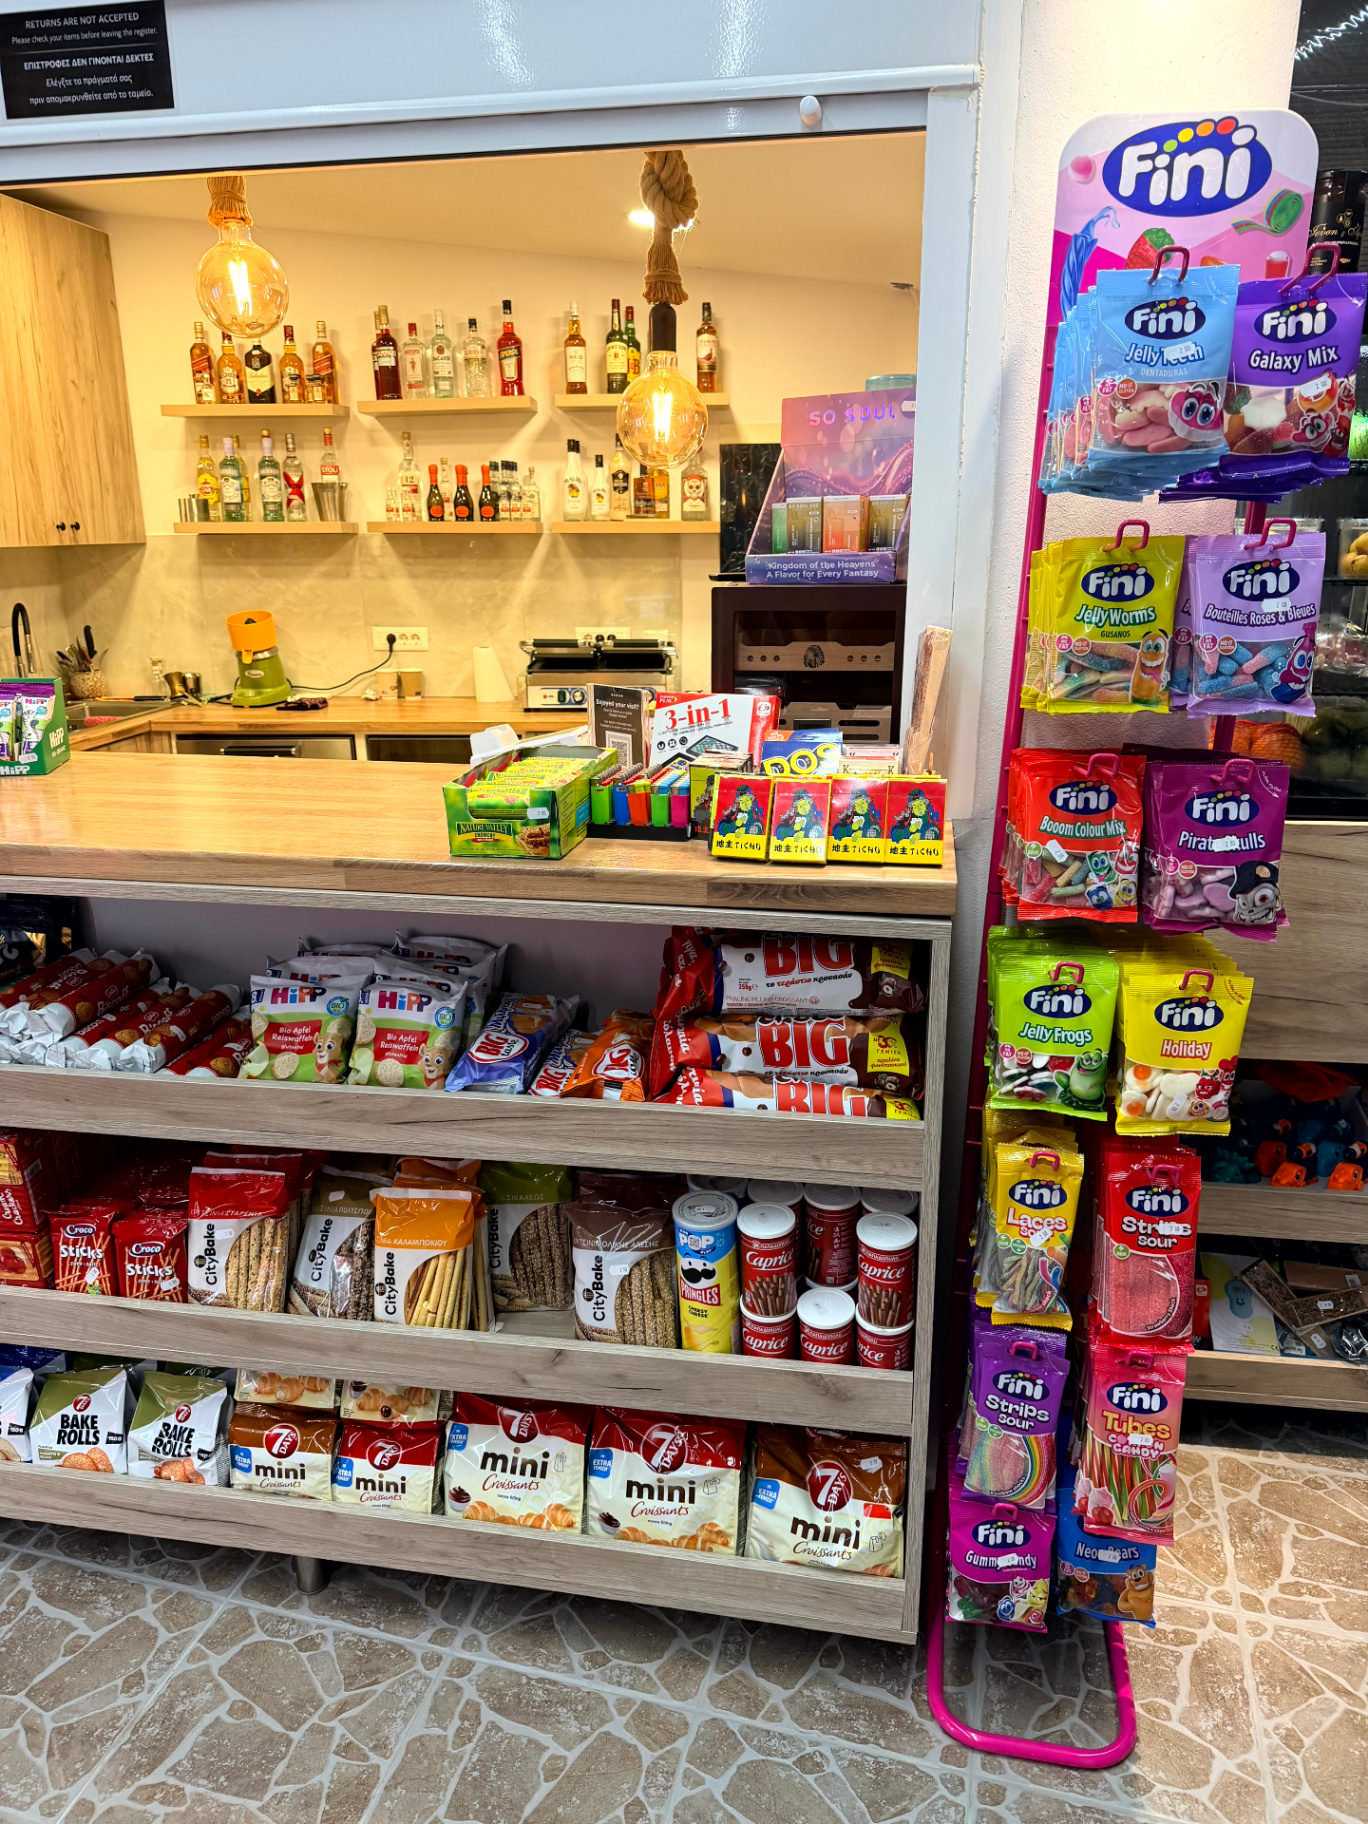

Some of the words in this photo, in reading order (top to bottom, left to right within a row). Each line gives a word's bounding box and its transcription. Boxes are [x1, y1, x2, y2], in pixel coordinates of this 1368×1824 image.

[25, 18, 61, 29] RETURNS
[63, 17, 78, 26] ARE
[80, 15, 96, 25] NOT
[99, 12, 139, 23] ACCEPTED
[12, 36, 30, 44] Please
[32, 34, 48, 43] check
[49, 35, 62, 44] your
[63, 32, 80, 40] items
[81, 30, 100, 39] before
[101, 29, 122, 39] leaving
[134, 27, 157, 37] register.
[24, 60, 70, 70] ΕΠΙΣΤΡΟΦΕΣ
[72, 58, 87, 66] ΔΕΝ
[89, 55, 124, 65] ΓΙΝΟΝΤΑΙ
[125, 53, 154, 63] ΔΕΚΤΕΣ
[119, 75, 132, 83] σας
[1118, 117, 1256, 206] Fini
[1132, 301, 1197, 334] Fini
[1262, 301, 1328, 339] Fini
[1125, 343, 1160, 366] Jelly
[1250, 349, 1302, 373] Galaxy
[1307, 346, 1339, 367] Mix
[1140, 368, 1188, 377] DENTADURAS
[809, 409, 836, 427] SO
[844, 404, 897, 423] SOUL
[768, 560, 806, 571] Kingdom
[810, 560, 819, 569] of
[820, 561, 835, 570] the
[837, 559, 875, 570] Heavens
[775, 570, 800, 580] Flavor
[802, 570, 815, 579] for
[817, 569, 841, 580] Every
[844, 568, 879, 579] Fantasy
[1088, 567, 1146, 597] Fini
[1229, 562, 1290, 597] Fini
[1075, 604, 1108, 626] Jelly
[1108, 606, 1156, 624] Worms
[1204, 604, 1248, 624] Bouteilles
[1250, 611, 1276, 625] Roses
[1278, 610, 1286, 623] &
[1287, 602, 1316, 621] Bleues
[1100, 630, 1131, 638] GUSANOS
[596, 699, 614, 708] Enjoyed
[665, 698, 732, 730] 3-in-1
[0, 765, 30, 775] HiPP
[1055, 784, 1110, 810] Fini
[1192, 793, 1251, 822] Fini
[1040, 815, 1073, 836] Booom
[1075, 822, 1105, 837] Colour
[1106, 820, 1127, 834] Mix
[716, 839, 733, 849] 地主
[774, 844, 791, 853] 地主
[832, 843, 849, 853] 地主
[1178, 831, 1214, 849] Pirat
[889, 847, 907, 856] 地主
[763, 933, 854, 977] BIG
[776, 977, 812, 988] τεράστιο
[812, 972, 853, 985] κρουασάν
[271, 986, 327, 1005] HiPP
[331, 1001, 345, 1010] BIO
[377, 990, 432, 1013] HiPP
[1030, 988, 1084, 1014] Fini
[438, 1012, 452, 1022] BIO
[1161, 1000, 1216, 1027] Fini
[272, 1034, 314, 1043] Reiswaffeln
[292, 1026, 311, 1035] Apfel
[387, 1033, 397, 1041] Bio
[398, 1034, 417, 1044] Apfel
[1019, 1023, 1053, 1042] Jelly
[1054, 1027, 1093, 1046] Frogs
[380, 1042, 419, 1052] Reiswaffeln
[474, 1033, 509, 1057] BIG
[758, 1018, 850, 1068] BIG
[1162, 1039, 1211, 1059] Holiday
[536, 1067, 567, 1091] BIG
[776, 1079, 868, 1117] BIG
[1014, 1184, 1061, 1205] Fini
[1131, 1188, 1182, 1212] Fini
[66, 1224, 94, 1235] Croco
[1007, 1207, 1068, 1230] Laces
[132, 1242, 162, 1254] Croco
[488, 1207, 500, 1270] CityBake
[1137, 1235, 1178, 1249] sour
[60, 1244, 103, 1260] Sticks
[203, 1222, 219, 1286] CityBake
[311, 1218, 333, 1282] CityBake
[126, 1262, 173, 1278] Sticks
[384, 1251, 399, 1316] CityBake
[592, 1253, 608, 1322] CityBake
[680, 1279, 719, 1305] PRINGLES
[743, 1328, 790, 1351] Caprice
[800, 1334, 849, 1356] Caprice
[997, 1373, 1044, 1400] Fini
[985, 1394, 1050, 1422] Strips
[1112, 1386, 1161, 1411] Fini
[60, 1413, 98, 1430] BAKE
[502, 1410, 521, 1438] 7
[518, 1411, 534, 1438] DAYS
[998, 1414, 1035, 1430] sour
[1102, 1410, 1171, 1440] Tubes
[56, 1429, 100, 1446] ROLLS
[158, 1422, 196, 1445] BAKE
[269, 1428, 293, 1455] 7
[279, 1431, 297, 1455] DAYS
[151, 1437, 192, 1458] ROLLS
[374, 1442, 395, 1467] 7
[651, 1432, 676, 1470] 7
[1113, 1443, 1160, 1459] CANDY
[255, 1460, 306, 1480] mini
[480, 1446, 550, 1480] mini
[593, 1458, 612, 1467] EXTRA
[259, 1476, 302, 1489] Croissants
[355, 1472, 407, 1494] mini
[482, 1473, 541, 1492] Croissants
[626, 1477, 697, 1504] mini
[815, 1469, 839, 1508] 7
[827, 1471, 848, 1505] DAYS
[359, 1491, 403, 1503] Croissants
[630, 1501, 690, 1518] Croissants
[790, 1515, 861, 1550] mini
[977, 1524, 1025, 1546] Fini
[792, 1540, 853, 1560] Croissants
[965, 1550, 999, 1570] Gumm
